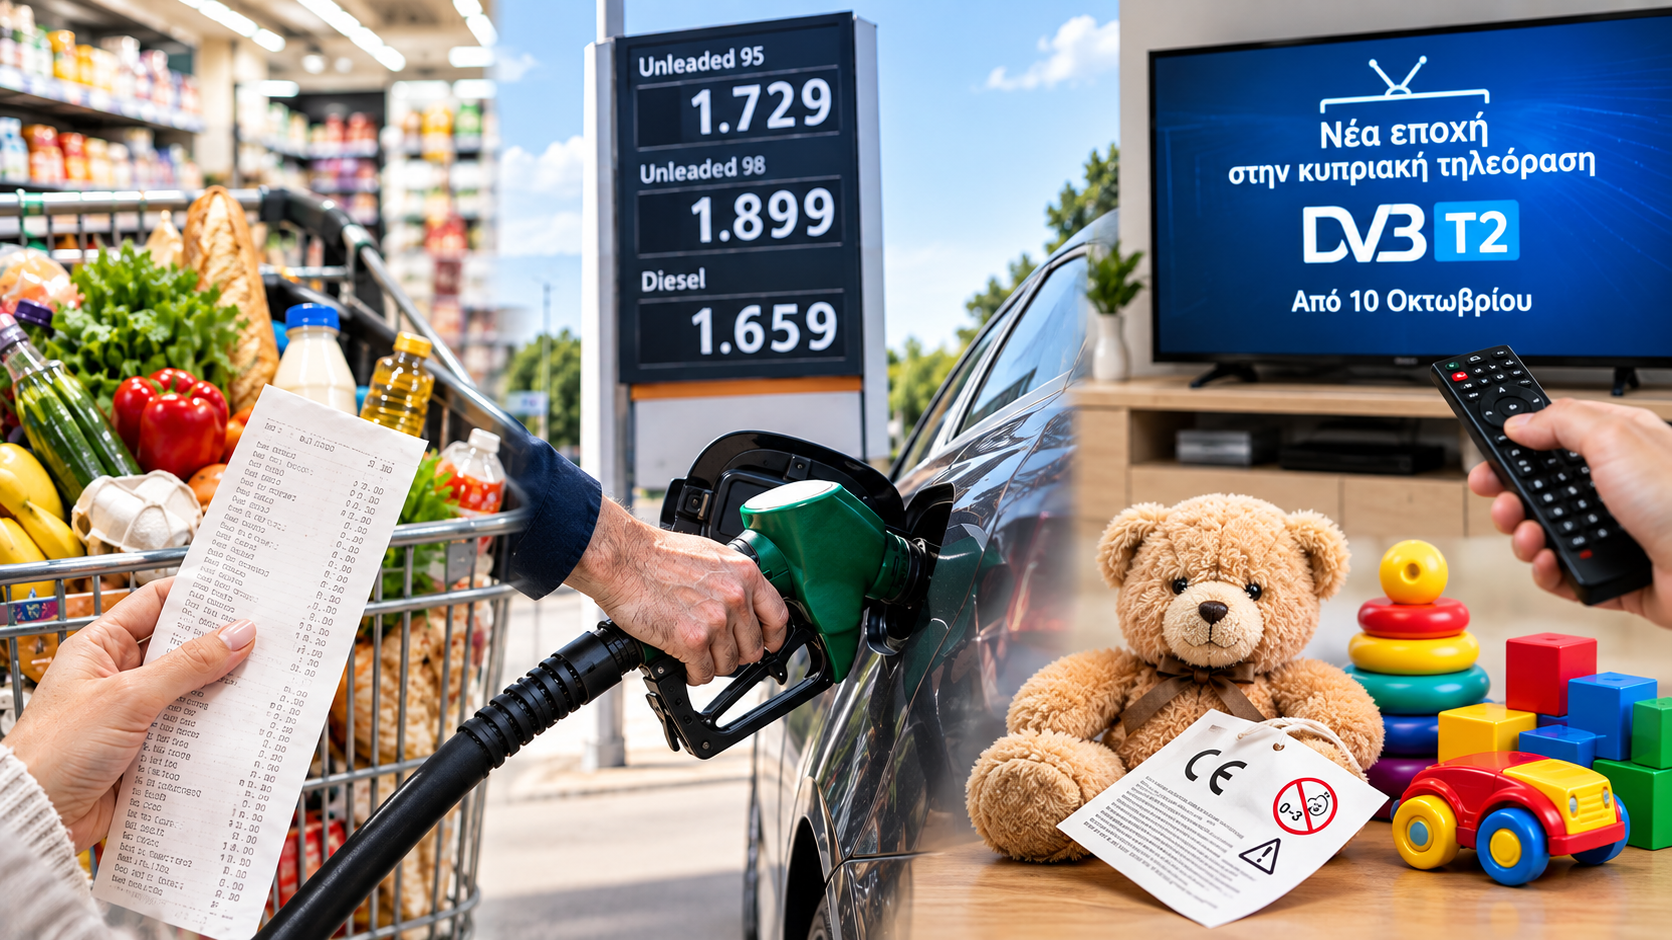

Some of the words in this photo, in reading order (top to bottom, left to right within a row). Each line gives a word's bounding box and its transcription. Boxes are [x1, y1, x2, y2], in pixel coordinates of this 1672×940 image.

[638, 47, 736, 77] Unleaded
[740, 45, 765, 67] 95
[691, 78, 832, 135] 1.729
[1320, 118, 1381, 149] Νέα
[1390, 111, 1489, 148] εποχή
[640, 156, 738, 184] Unleaded
[741, 155, 766, 176] 98
[1228, 163, 1291, 189] στην
[1298, 151, 1428, 186] κυπριακή
[1436, 148, 1596, 180] τηλεόραση
[691, 187, 835, 243] 1.899
[1445, 210, 1508, 254] T2
[641, 267, 706, 292] Diesel
[1291, 288, 1342, 313] Από
[1349, 289, 1380, 313] 10
[1386, 286, 1532, 318] Οκτωβρίου
[692, 301, 837, 355] 1.659
[1184, 749, 1248, 796] CE
[1277, 799, 1304, 823] 0-3
